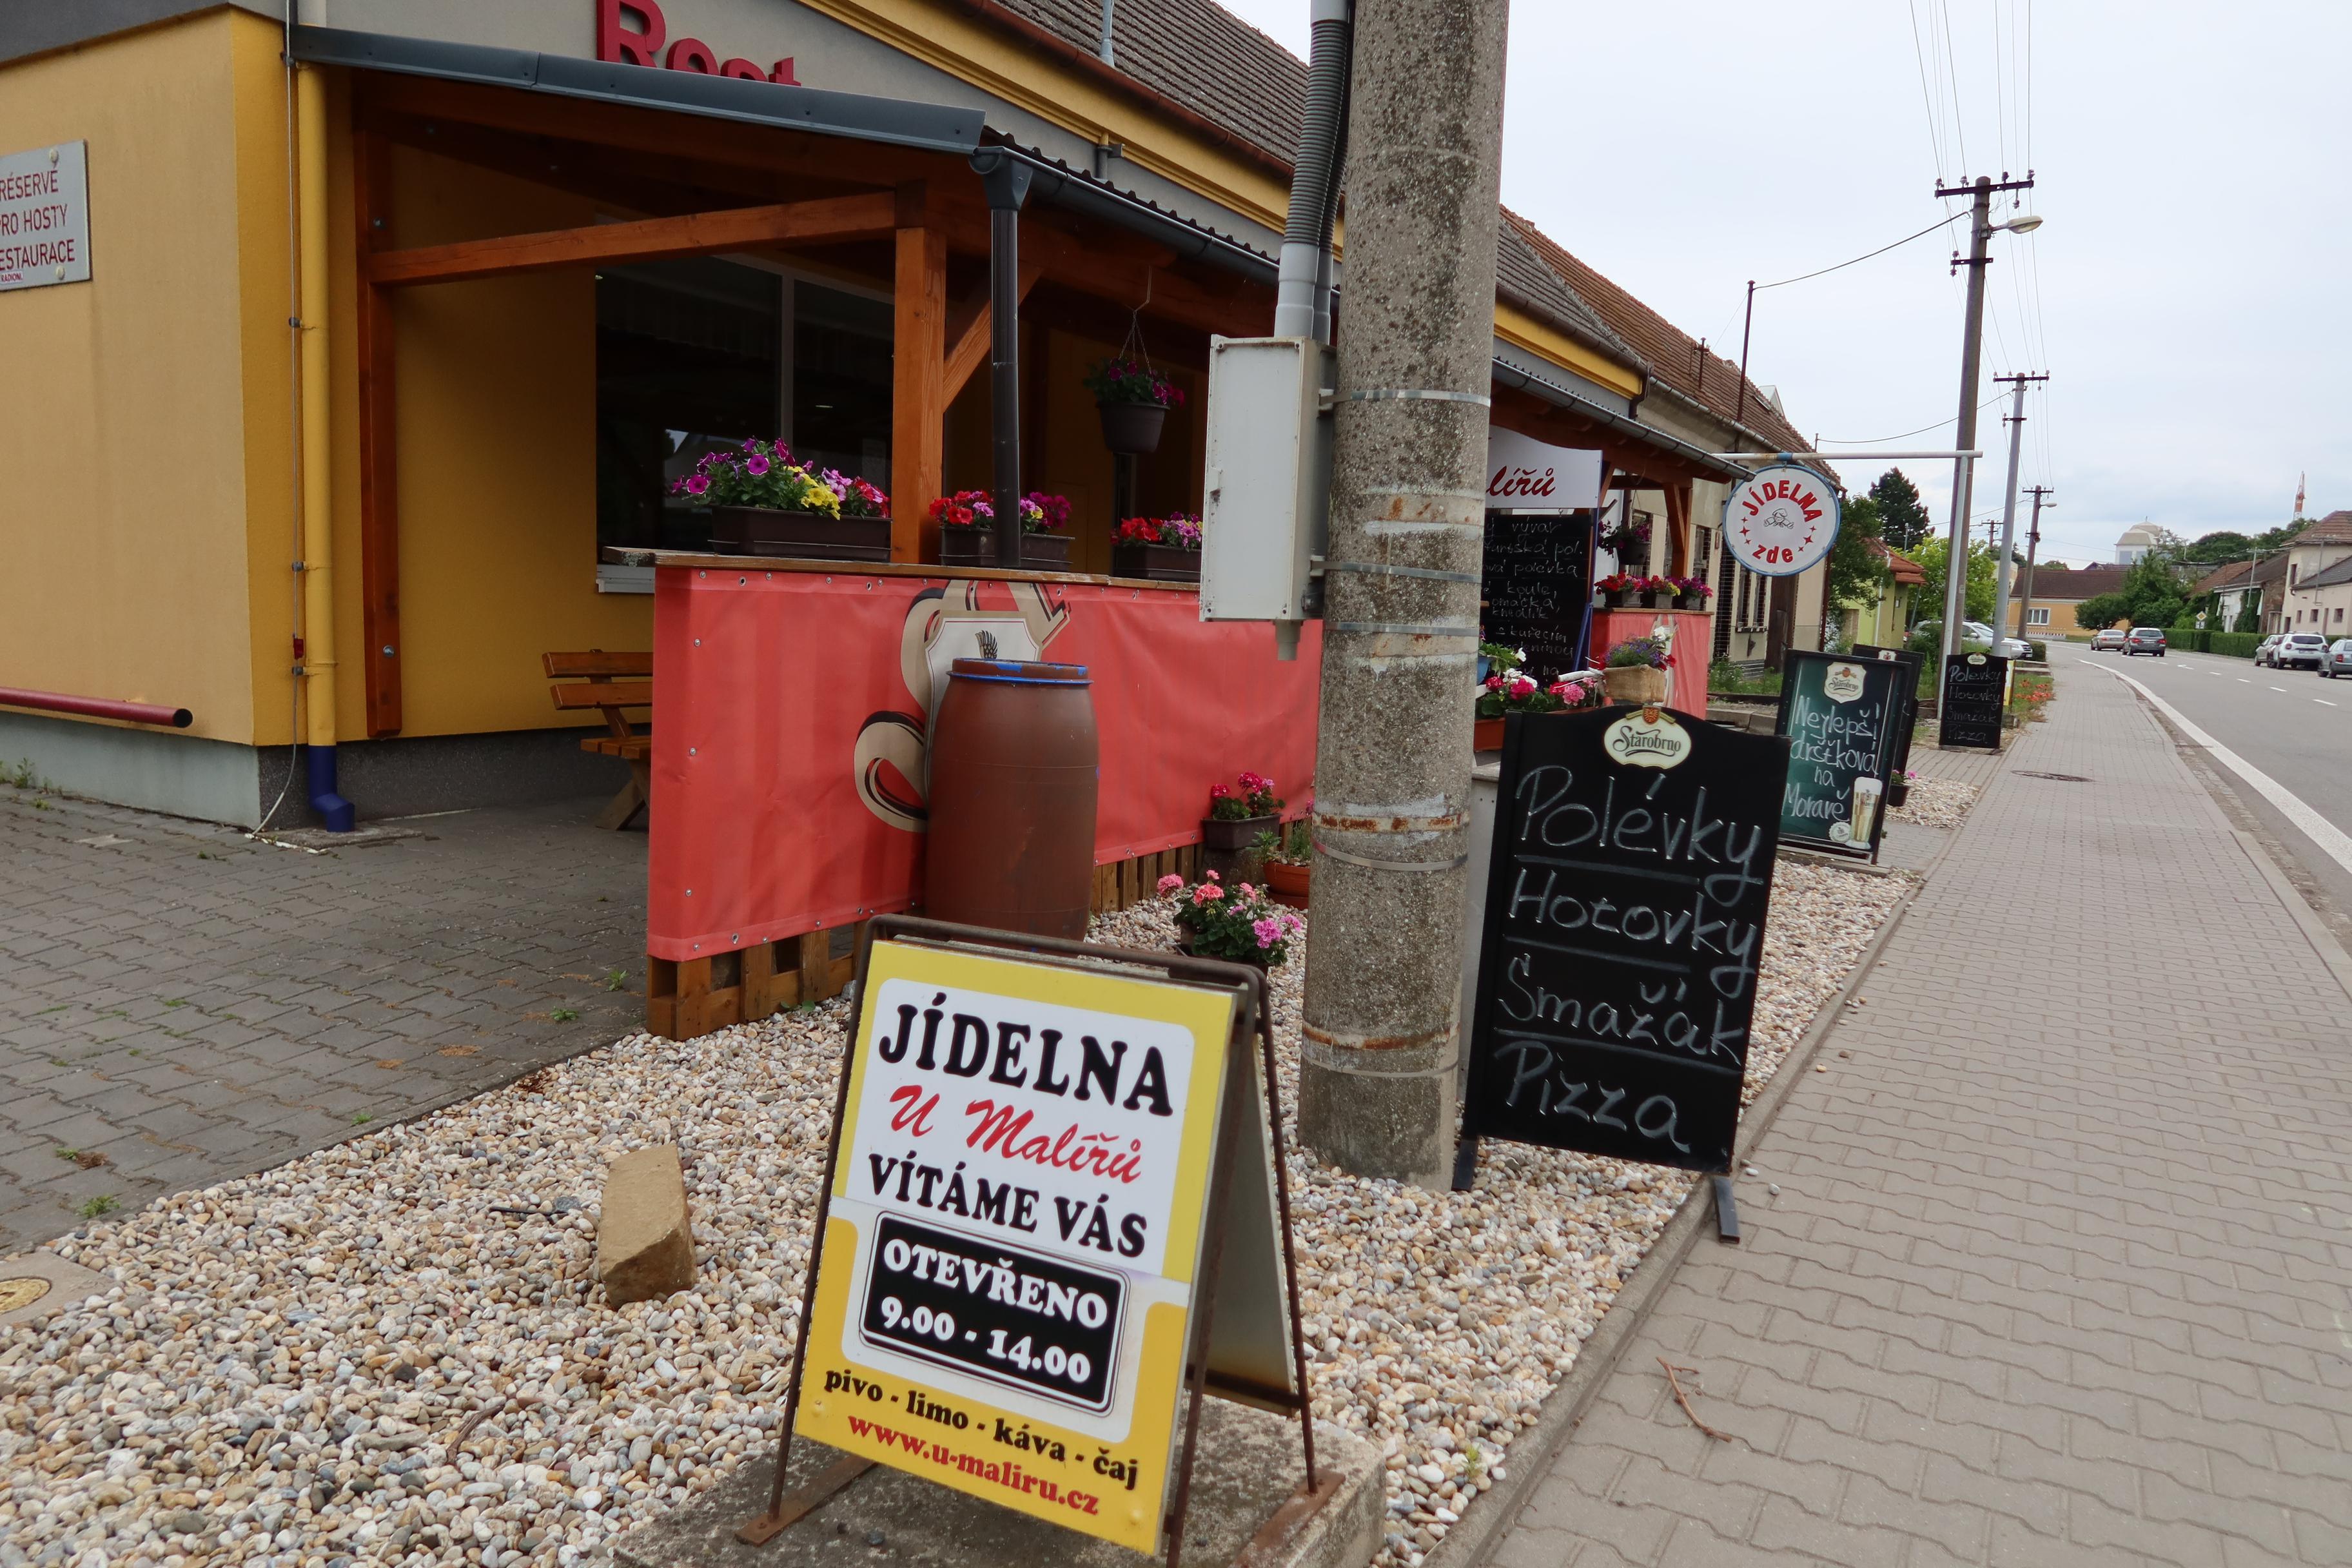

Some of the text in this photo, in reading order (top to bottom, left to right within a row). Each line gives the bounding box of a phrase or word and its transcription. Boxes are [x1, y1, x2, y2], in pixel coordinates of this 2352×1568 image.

[0, 204, 68, 237] RO HOSTY
[0, 239, 75, 271] ESTAURACE
[1485, 465, 1556, 496] lířů
[1742, 480, 1823, 523] JÍDELNA
[1512, 516, 1562, 542] vývar
[1514, 560, 1578, 578] polévka
[1554, 540, 1583, 562] pol.
[1752, 544, 1794, 564] zde
[1612, 725, 1681, 757] Starobrno
[1795, 695, 1880, 745] Nejlepší
[1947, 723, 1988, 744] Pizza
[1814, 765, 1836, 787] na
[1780, 782, 1850, 823] Moravě
[1515, 764, 1765, 903] Polévky
[1508, 867, 1757, 999] Hotovky
[878, 992, 1173, 1117] JÍDELNA
[1493, 1039, 1692, 1153] Pizza
[889, 1084, 1142, 1184] U Malířů
[868, 1150, 1148, 1258] VÍTÁME VÁS
[883, 1238, 1108, 1329] OTEVŘENO
[880, 1295, 956, 1342] 9.00
[986, 1328, 1092, 1384] 14.00
[823, 1368, 883, 1402] pivo
[905, 1389, 970, 1430] limo
[993, 1417, 1066, 1462] káva
[1092, 1446, 1139, 1491] čaj
[847, 1415, 1100, 1515] www.u-maliru.cz
